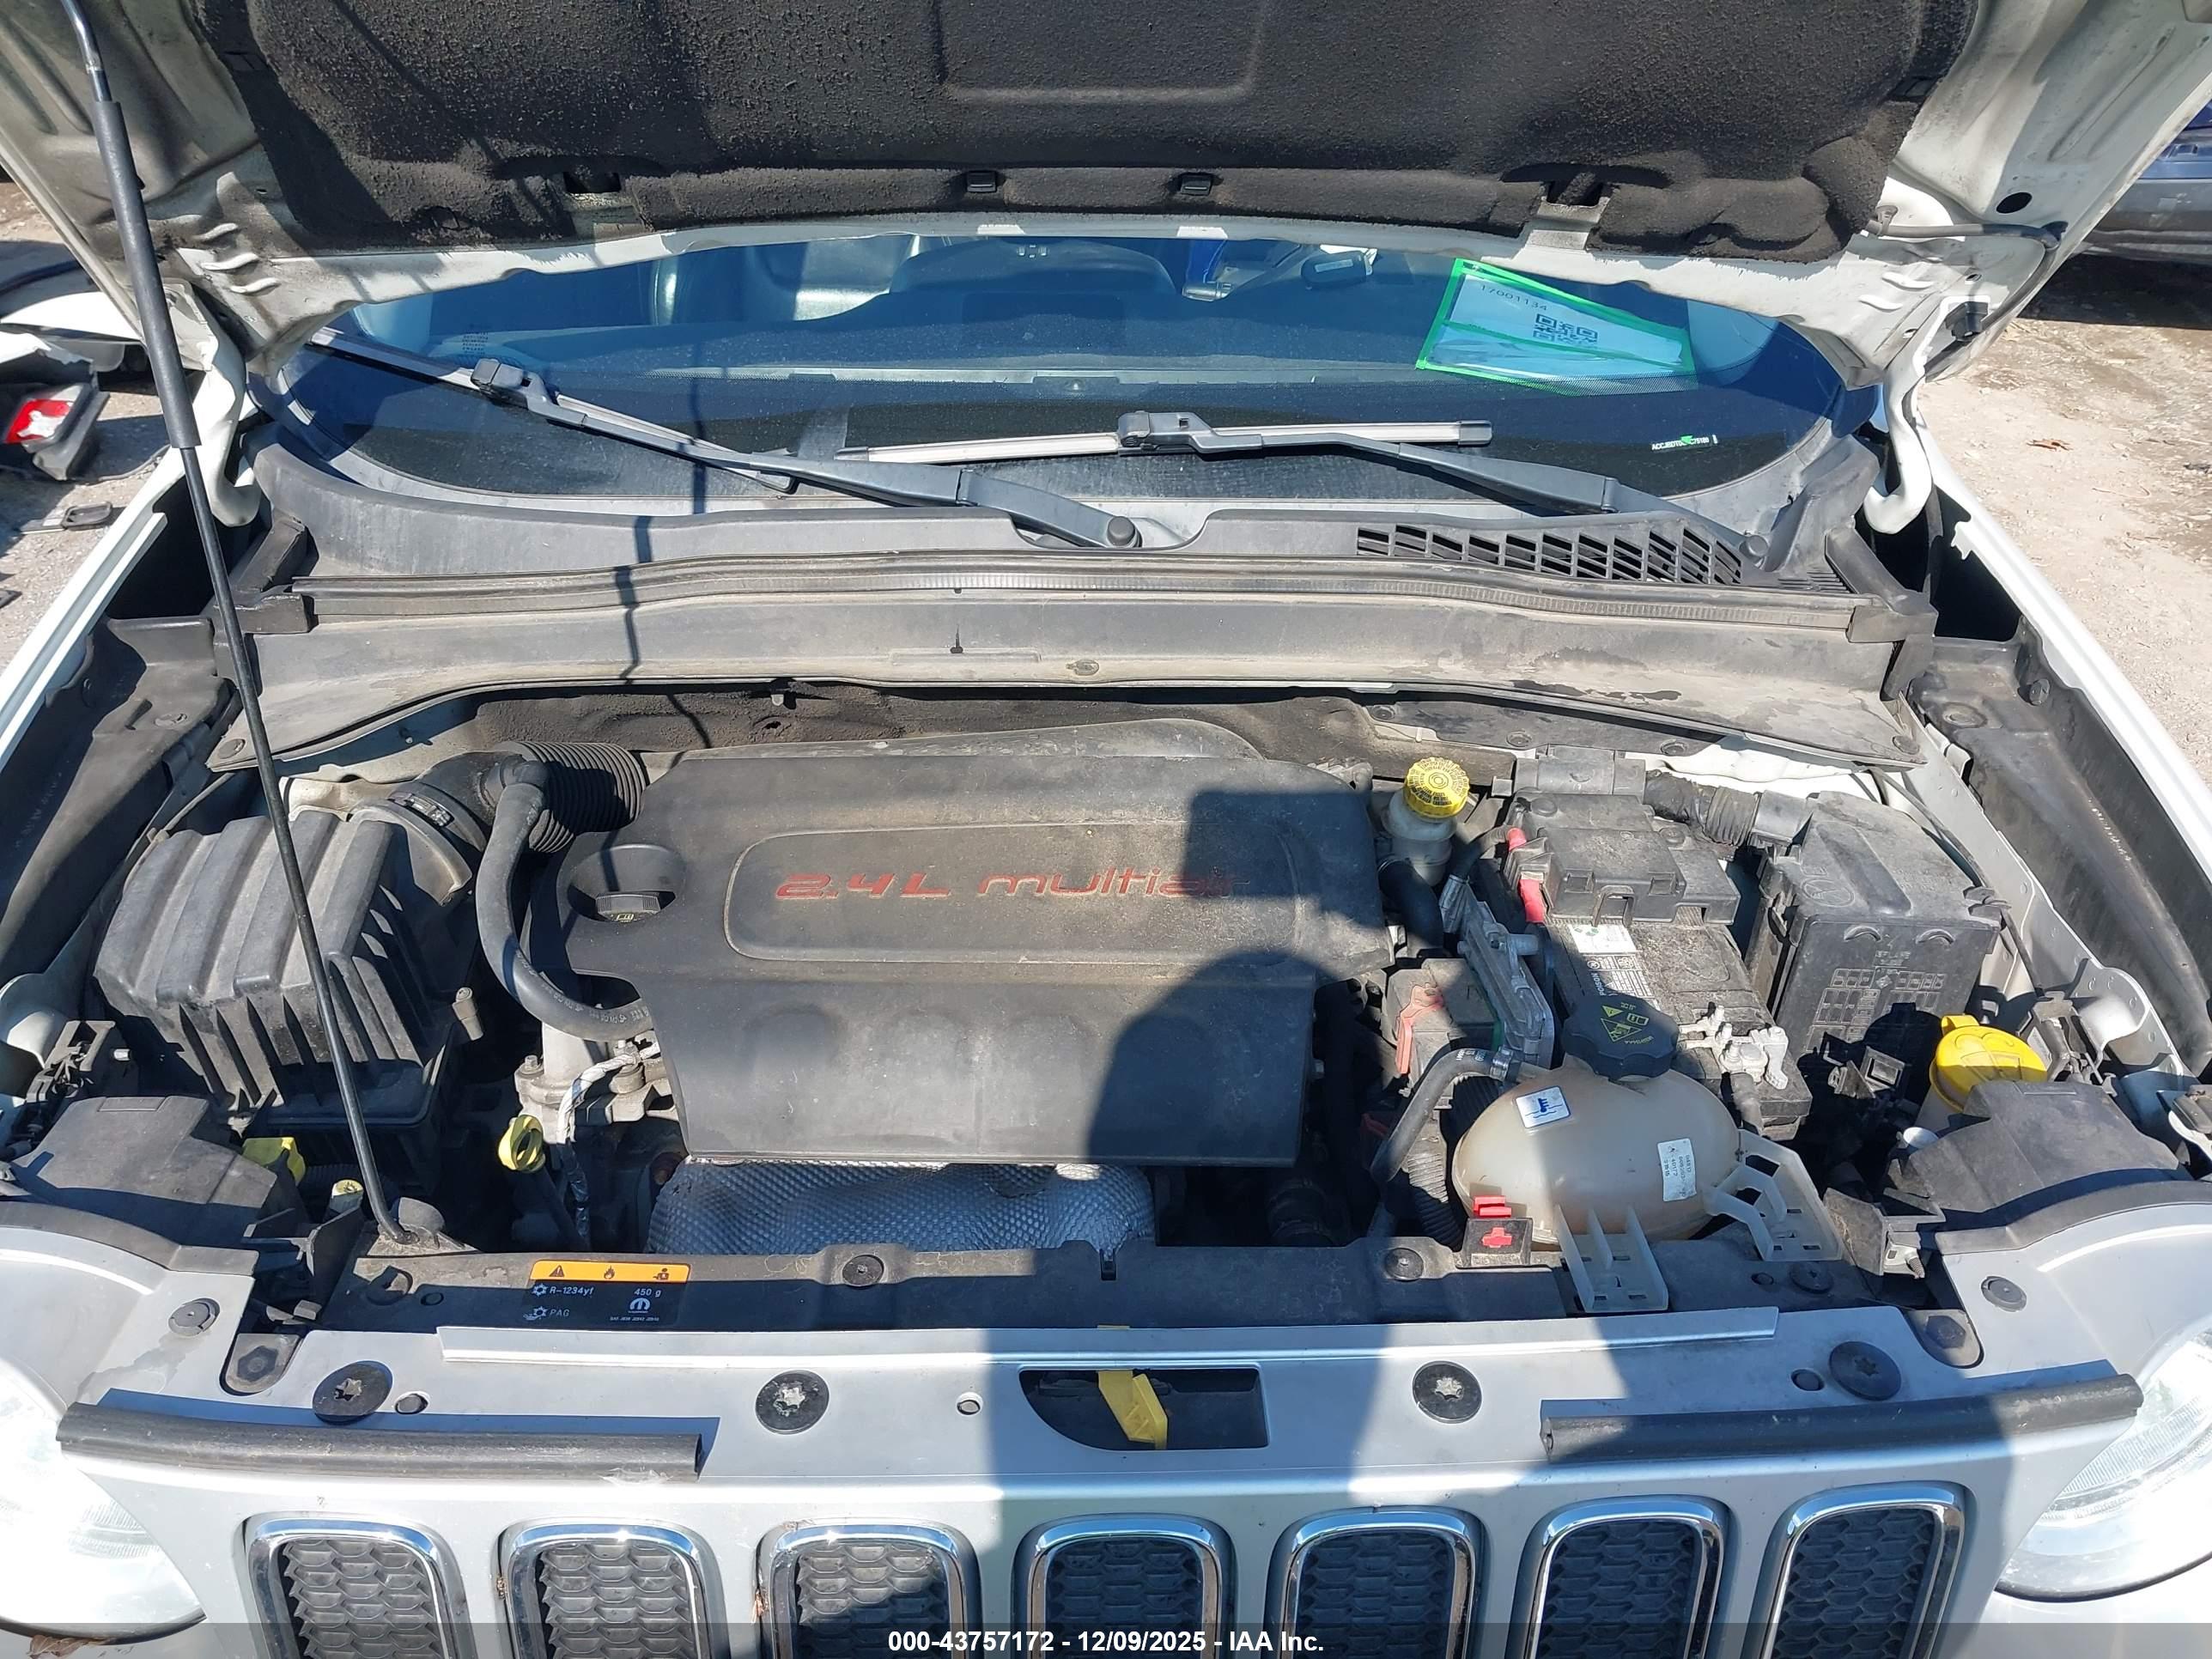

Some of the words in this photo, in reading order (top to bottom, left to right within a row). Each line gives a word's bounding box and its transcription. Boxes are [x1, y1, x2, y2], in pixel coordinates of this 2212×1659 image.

[1480, 285, 1547, 310] 17001134
[1591, 972, 1607, 996] POISON
[550, 1286, 594, 1296] R-1234yf
[550, 1309, 570, 1317] PAG
